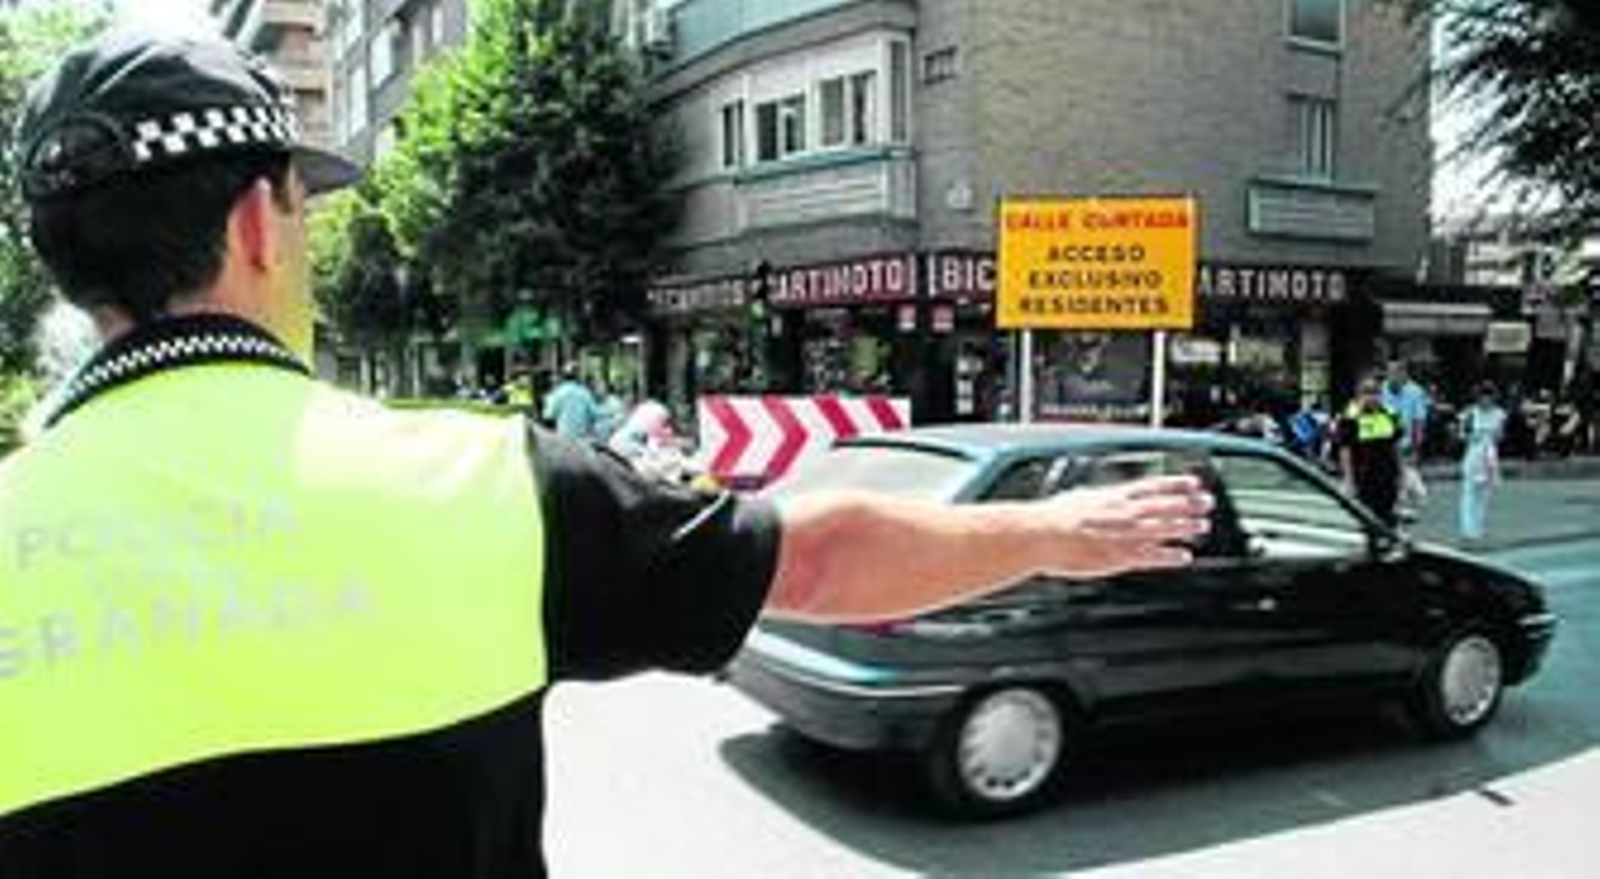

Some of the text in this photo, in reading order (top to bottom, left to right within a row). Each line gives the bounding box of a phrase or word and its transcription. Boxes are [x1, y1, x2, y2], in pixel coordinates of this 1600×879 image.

[1048, 244, 1147, 263] ACCESO
[1029, 268, 1164, 289] EXCLUSIVO
[1020, 295, 1169, 315] RESIDENTES
